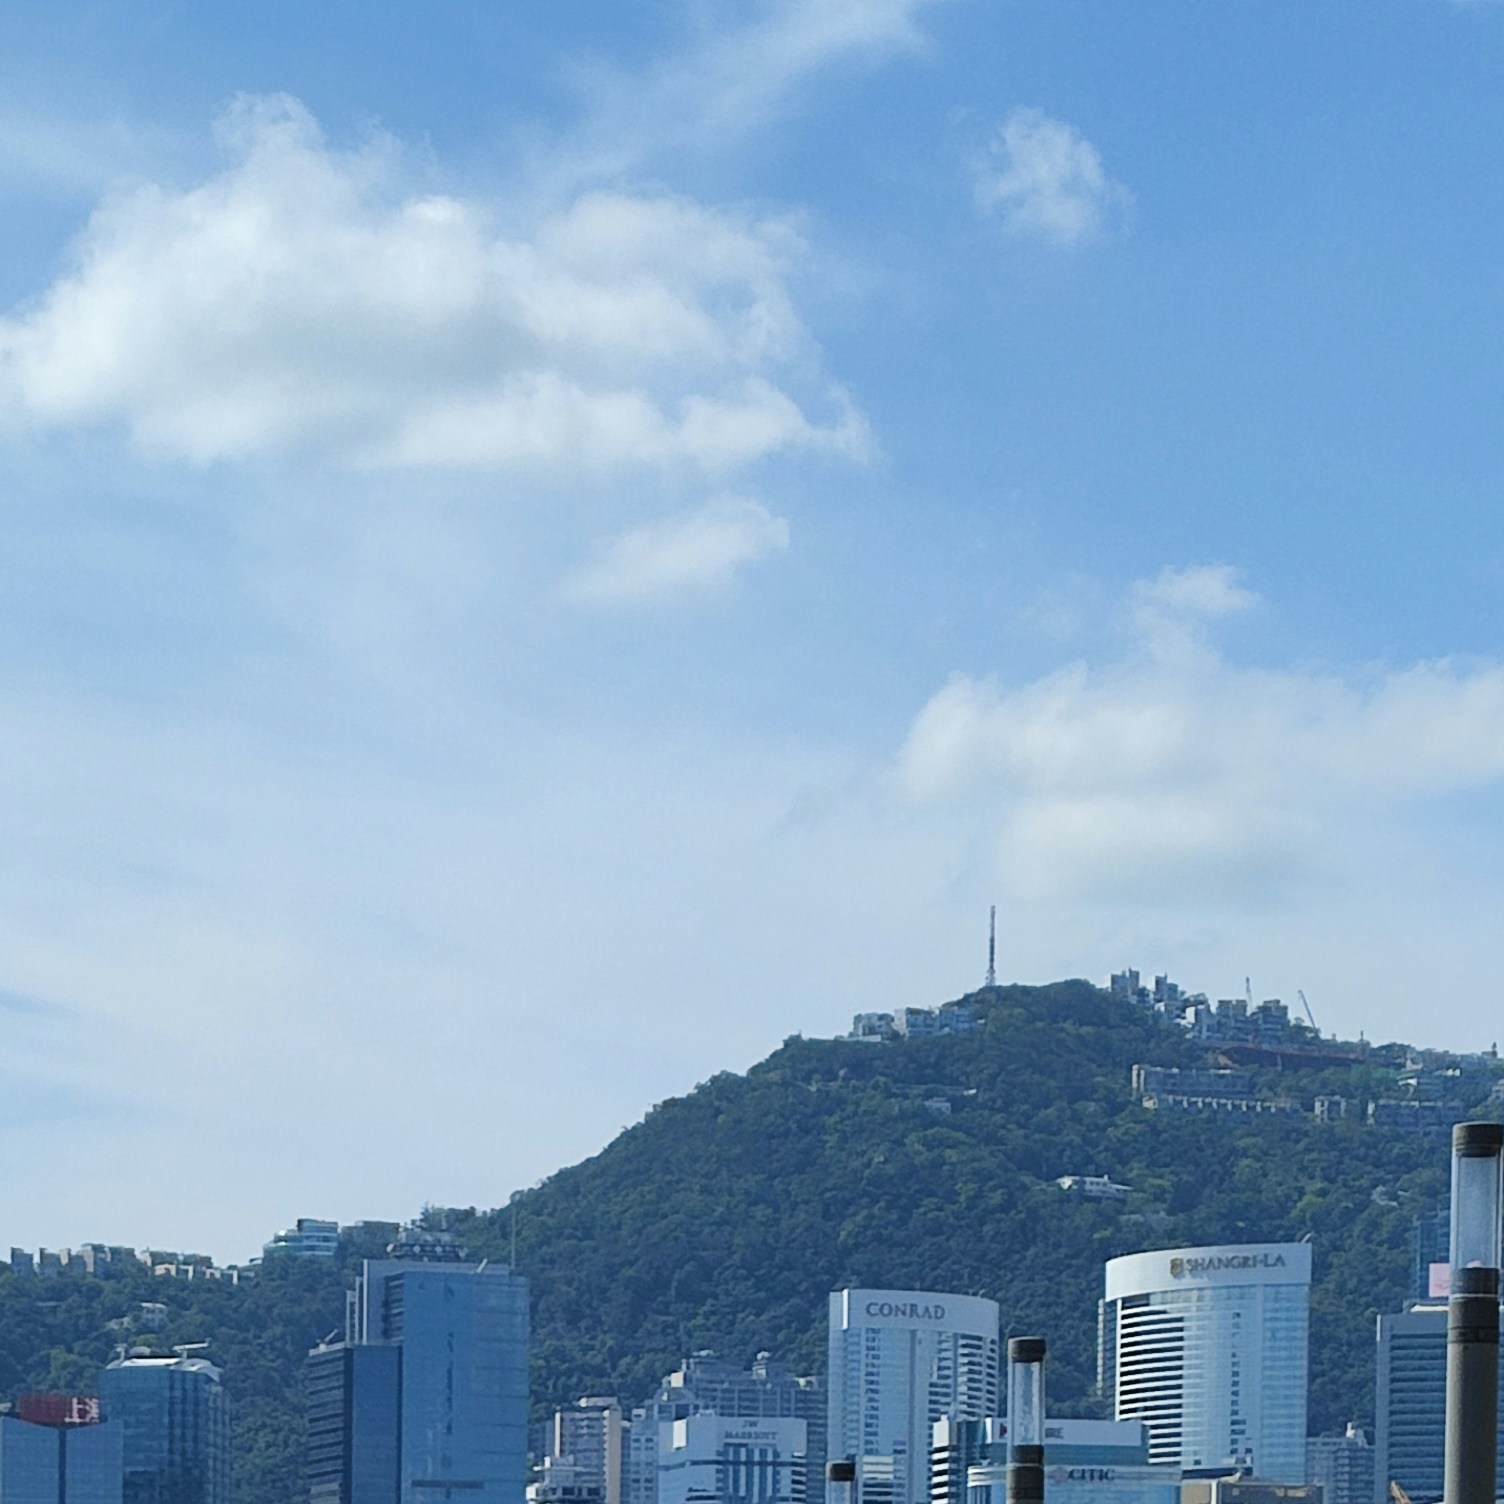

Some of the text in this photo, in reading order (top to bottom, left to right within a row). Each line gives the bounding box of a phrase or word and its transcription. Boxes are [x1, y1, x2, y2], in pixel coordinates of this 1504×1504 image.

[1186, 1254, 1287, 1271] SHANGRI-LA
[865, 1302, 946, 1320] CONRAD
[1068, 1469, 1115, 1481] CITIC
